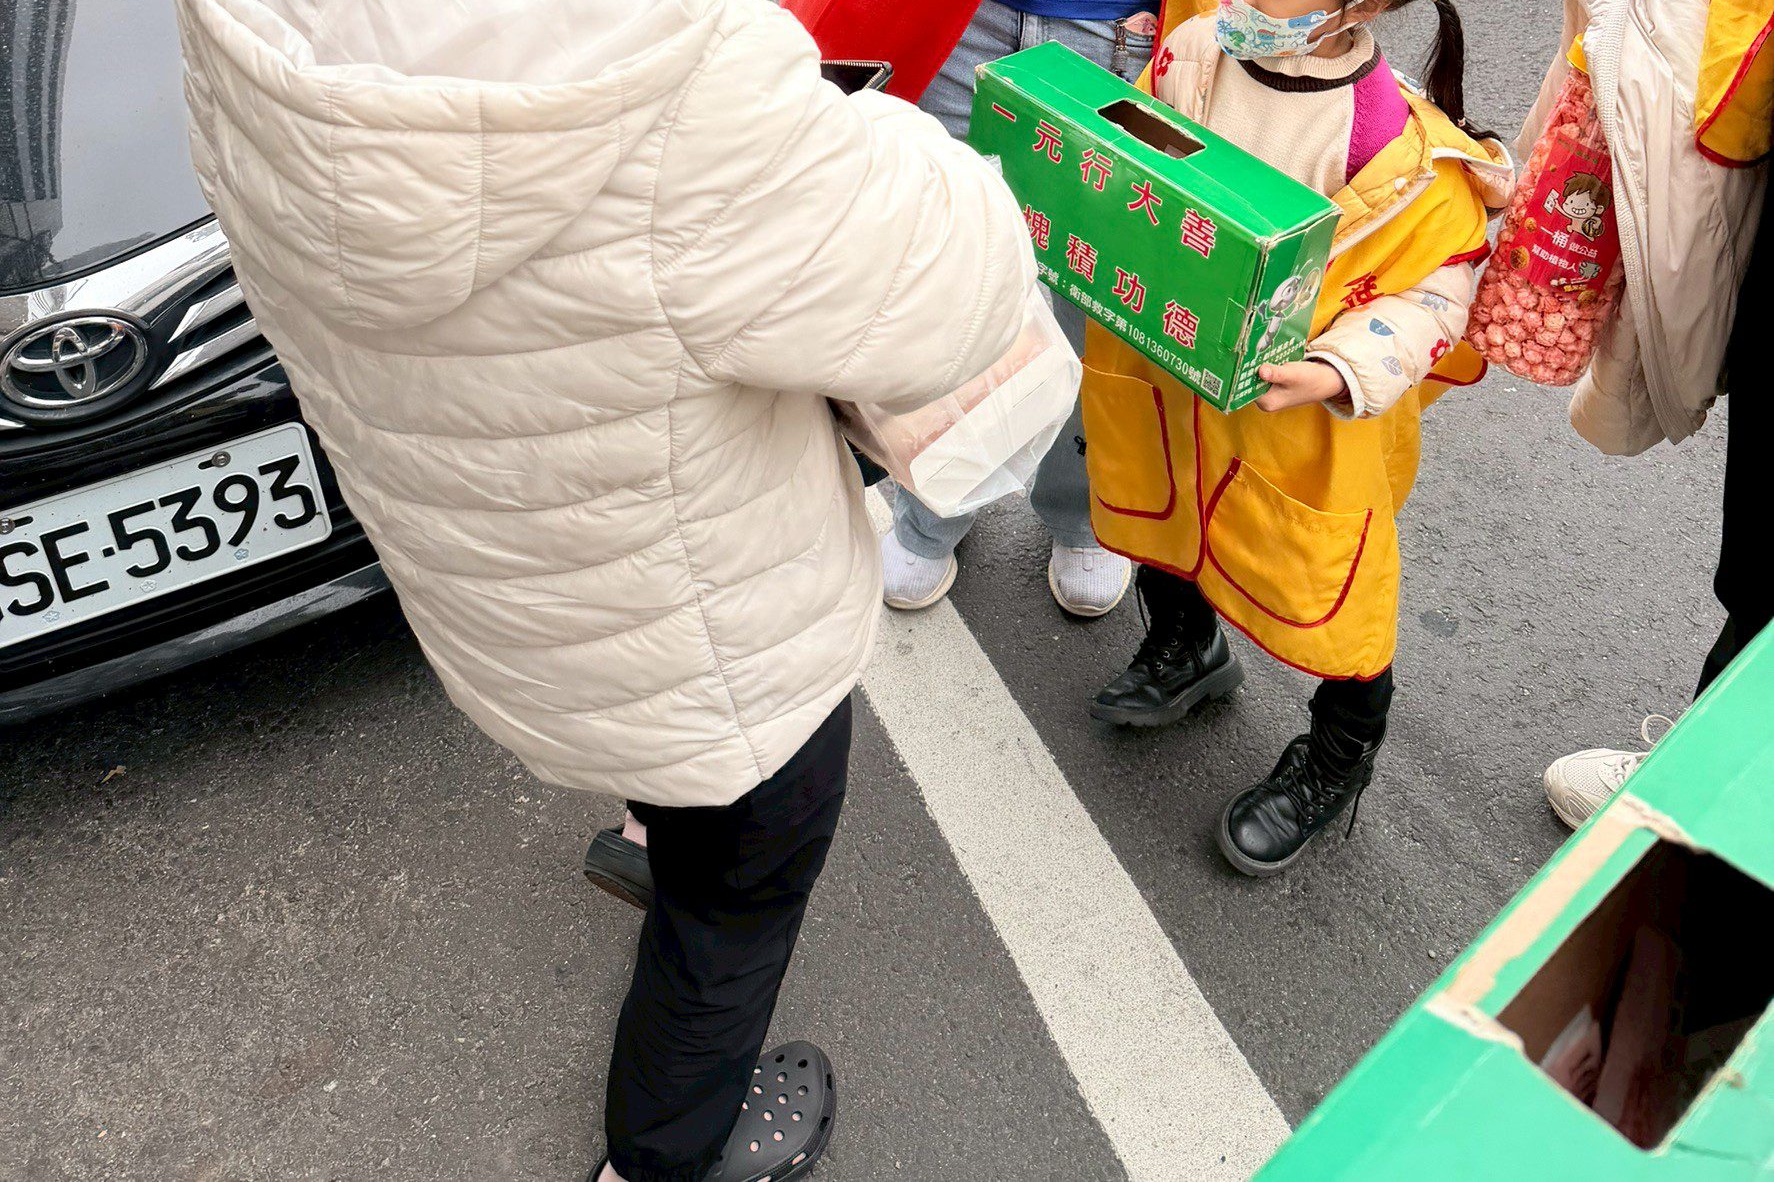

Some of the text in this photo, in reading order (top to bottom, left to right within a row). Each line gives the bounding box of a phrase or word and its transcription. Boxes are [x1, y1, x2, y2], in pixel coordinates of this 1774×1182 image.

[991, 102, 1217, 259] 一元行大善
[1023, 204, 1200, 350] 塊積功德
[0, 455, 321, 619] SE-5393
